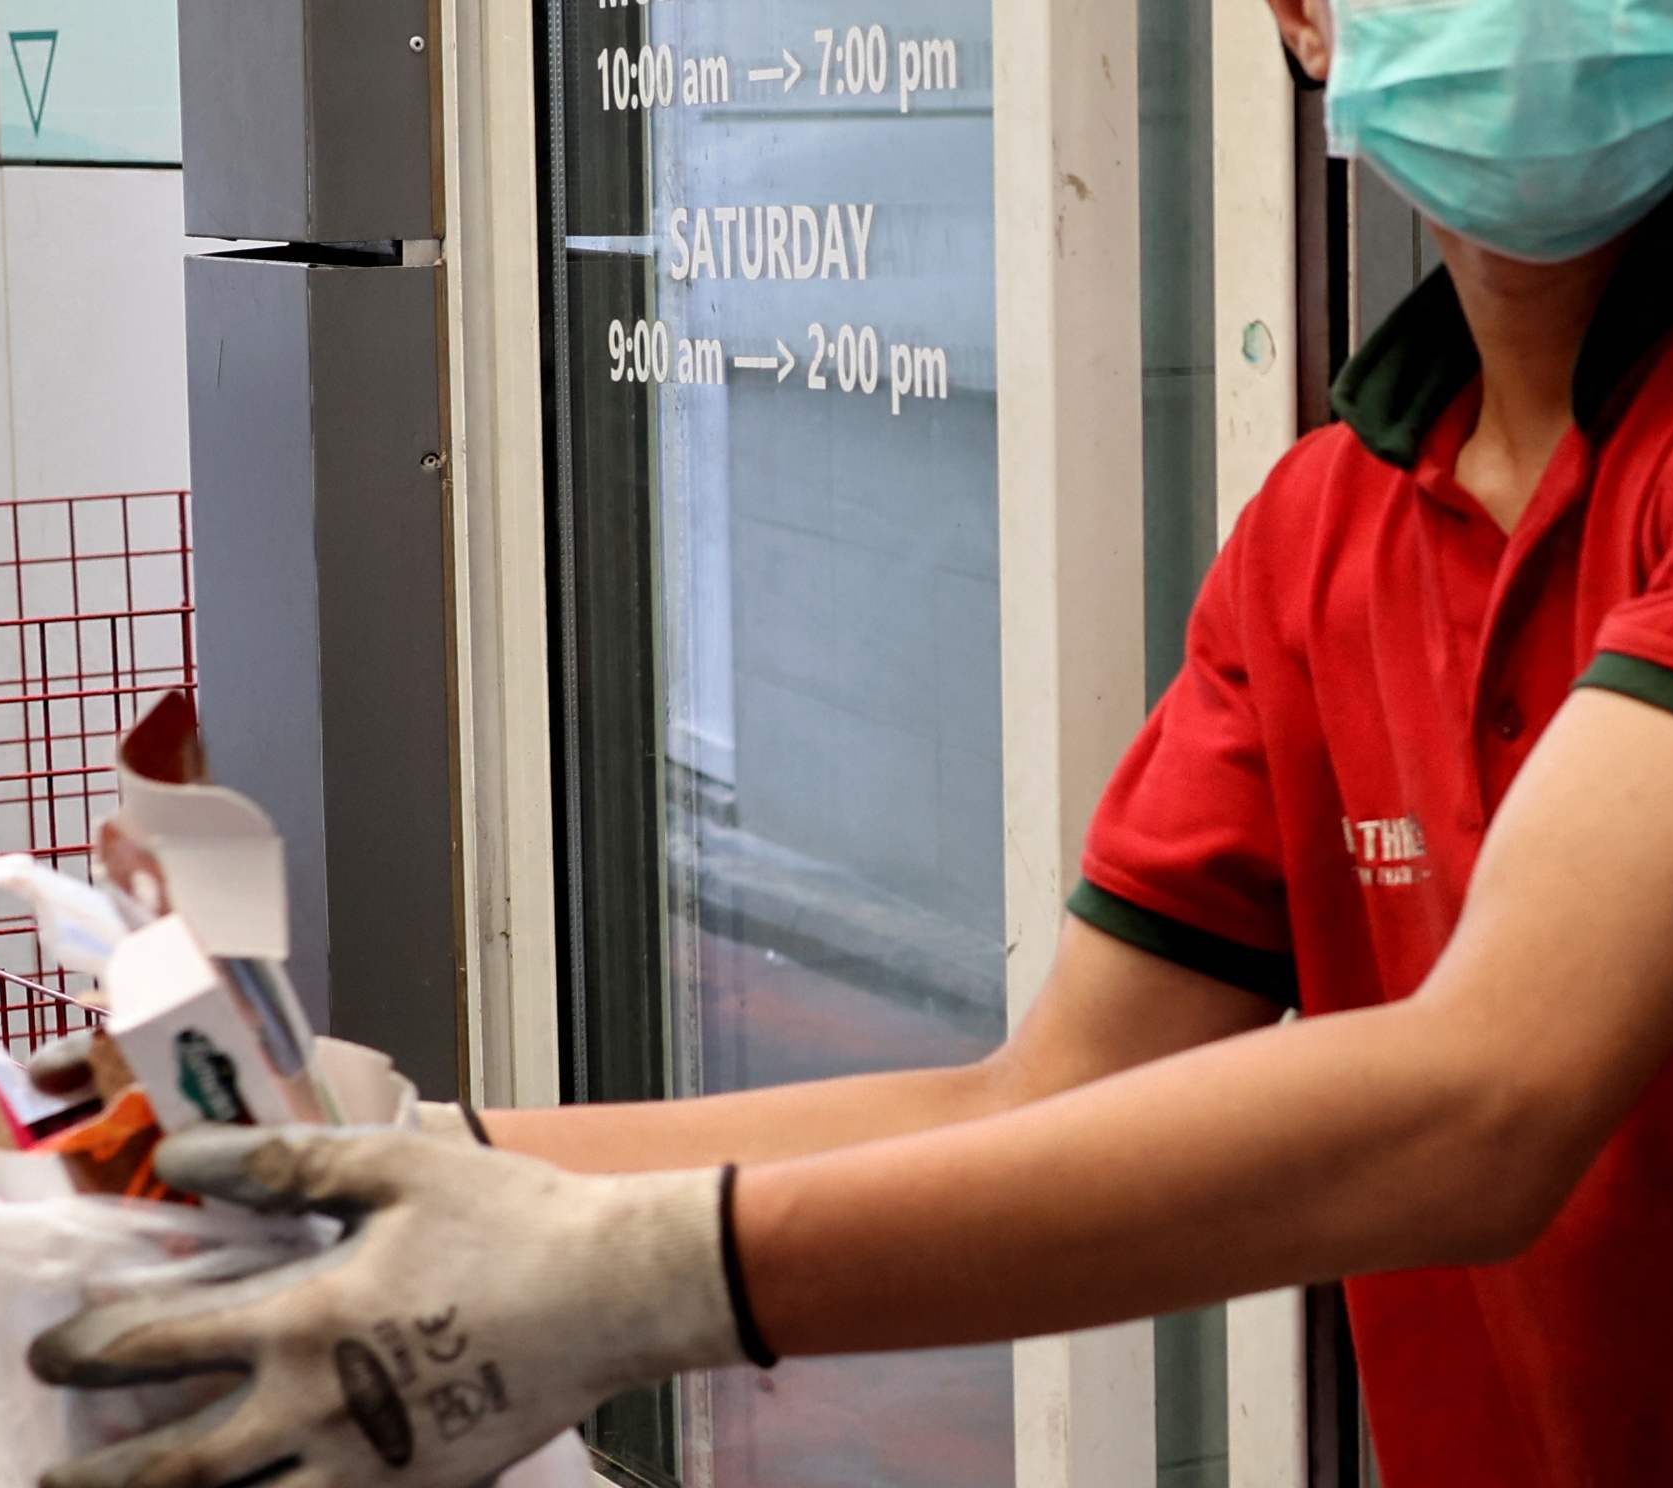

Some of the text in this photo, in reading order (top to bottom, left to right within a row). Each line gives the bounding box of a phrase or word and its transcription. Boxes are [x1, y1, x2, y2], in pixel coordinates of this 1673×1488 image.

[597, 23, 957, 113] 10:00 am 7:00 pm
[670, 203, 874, 281] SATURDAY
[608, 319, 669, 383] 9:00
[677, 335, 723, 384] am
[890, 343, 947, 415] pm
